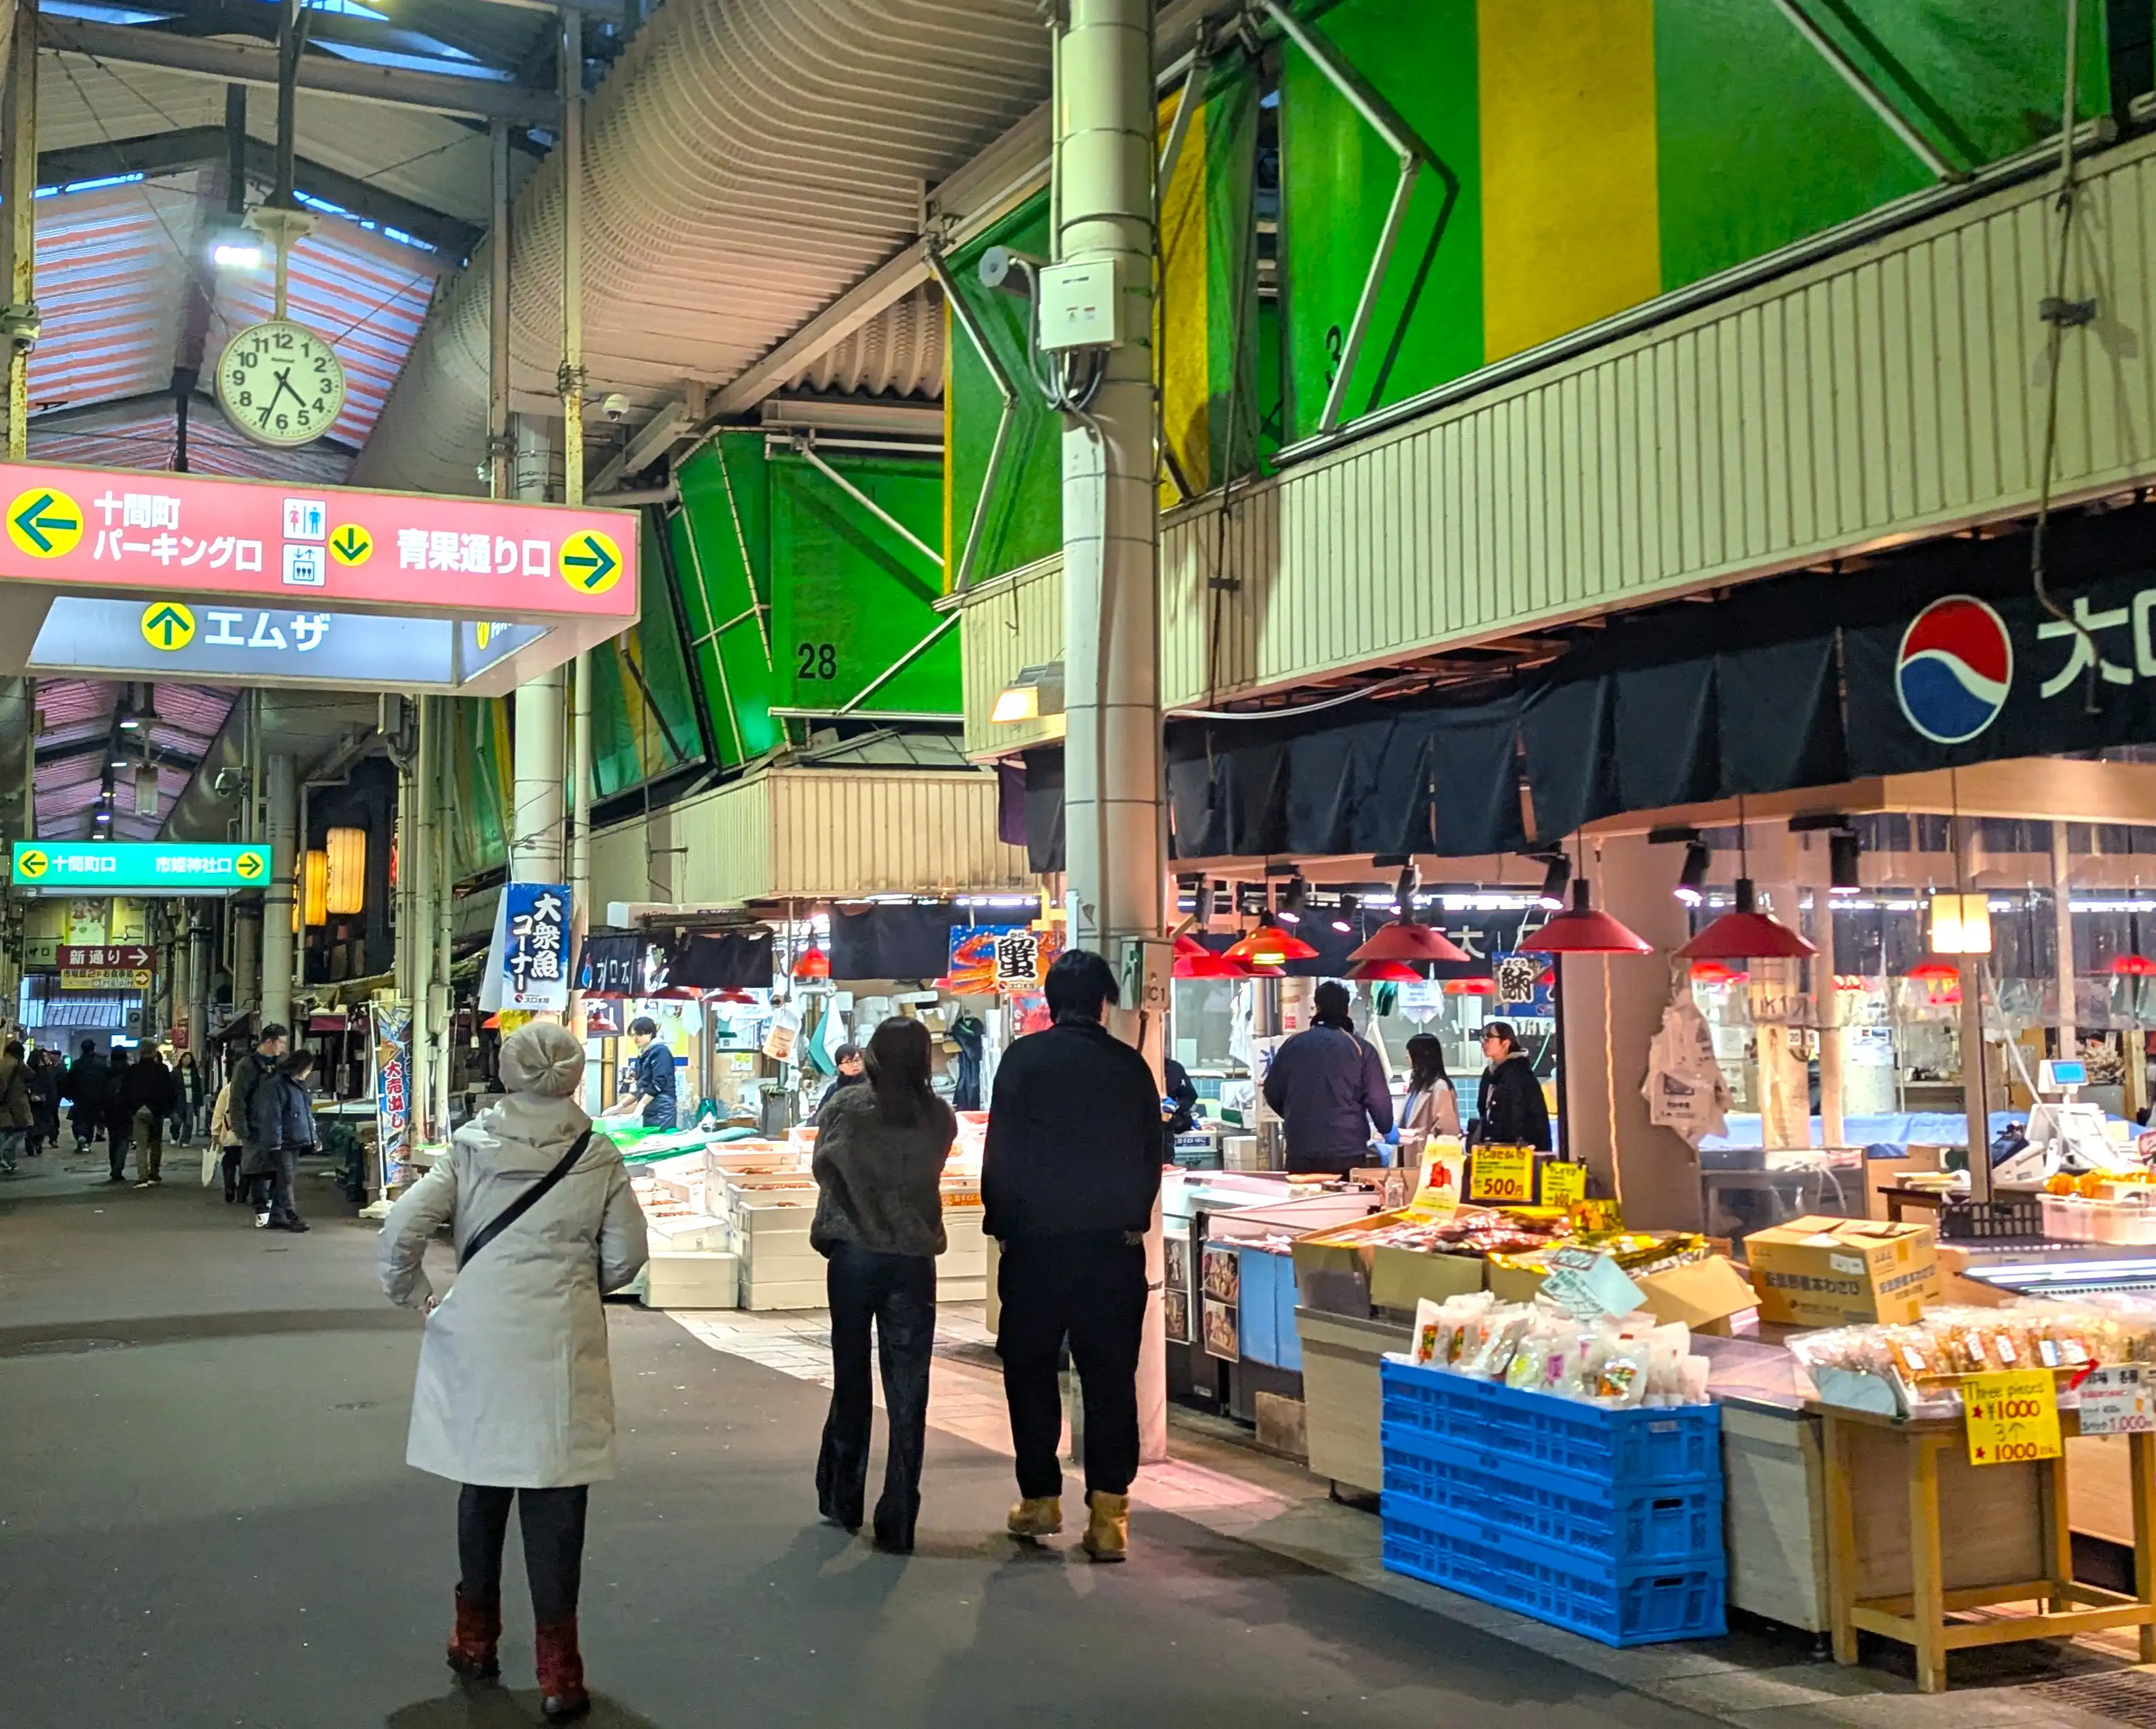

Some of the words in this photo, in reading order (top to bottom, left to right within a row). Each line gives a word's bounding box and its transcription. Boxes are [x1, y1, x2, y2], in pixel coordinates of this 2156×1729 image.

[252, 338, 269, 353] 11
[272, 333, 293, 349] 12
[301, 343, 309, 358] 1
[237, 351, 257, 368] 10
[314, 357, 327, 373] 2
[232, 370, 245, 386] 9
[320, 378, 332, 394] 3
[239, 391, 252, 406] 8
[312, 398, 324, 413] 4
[256, 406, 269, 422] 7
[276, 414, 288, 430] 6
[297, 410, 310, 426] 5
[93, 490, 181, 529] 十間町
[93, 530, 262, 572] パーキング口
[397, 529, 551, 577] 青果通り口
[204, 611, 331, 651] エムザ
[798, 643, 837, 680] 28
[51, 855, 116, 872] 十間町口
[156, 857, 232, 874] 市姫神社口
[531, 893, 562, 978] 大衆魚
[70, 949, 120, 964] 新通り
[510, 915, 533, 991] コーナー
[998, 939, 1036, 978] 蟹
[384, 1061, 405, 1129] 大売出し
[1963, 1381, 2003, 1401] Three
